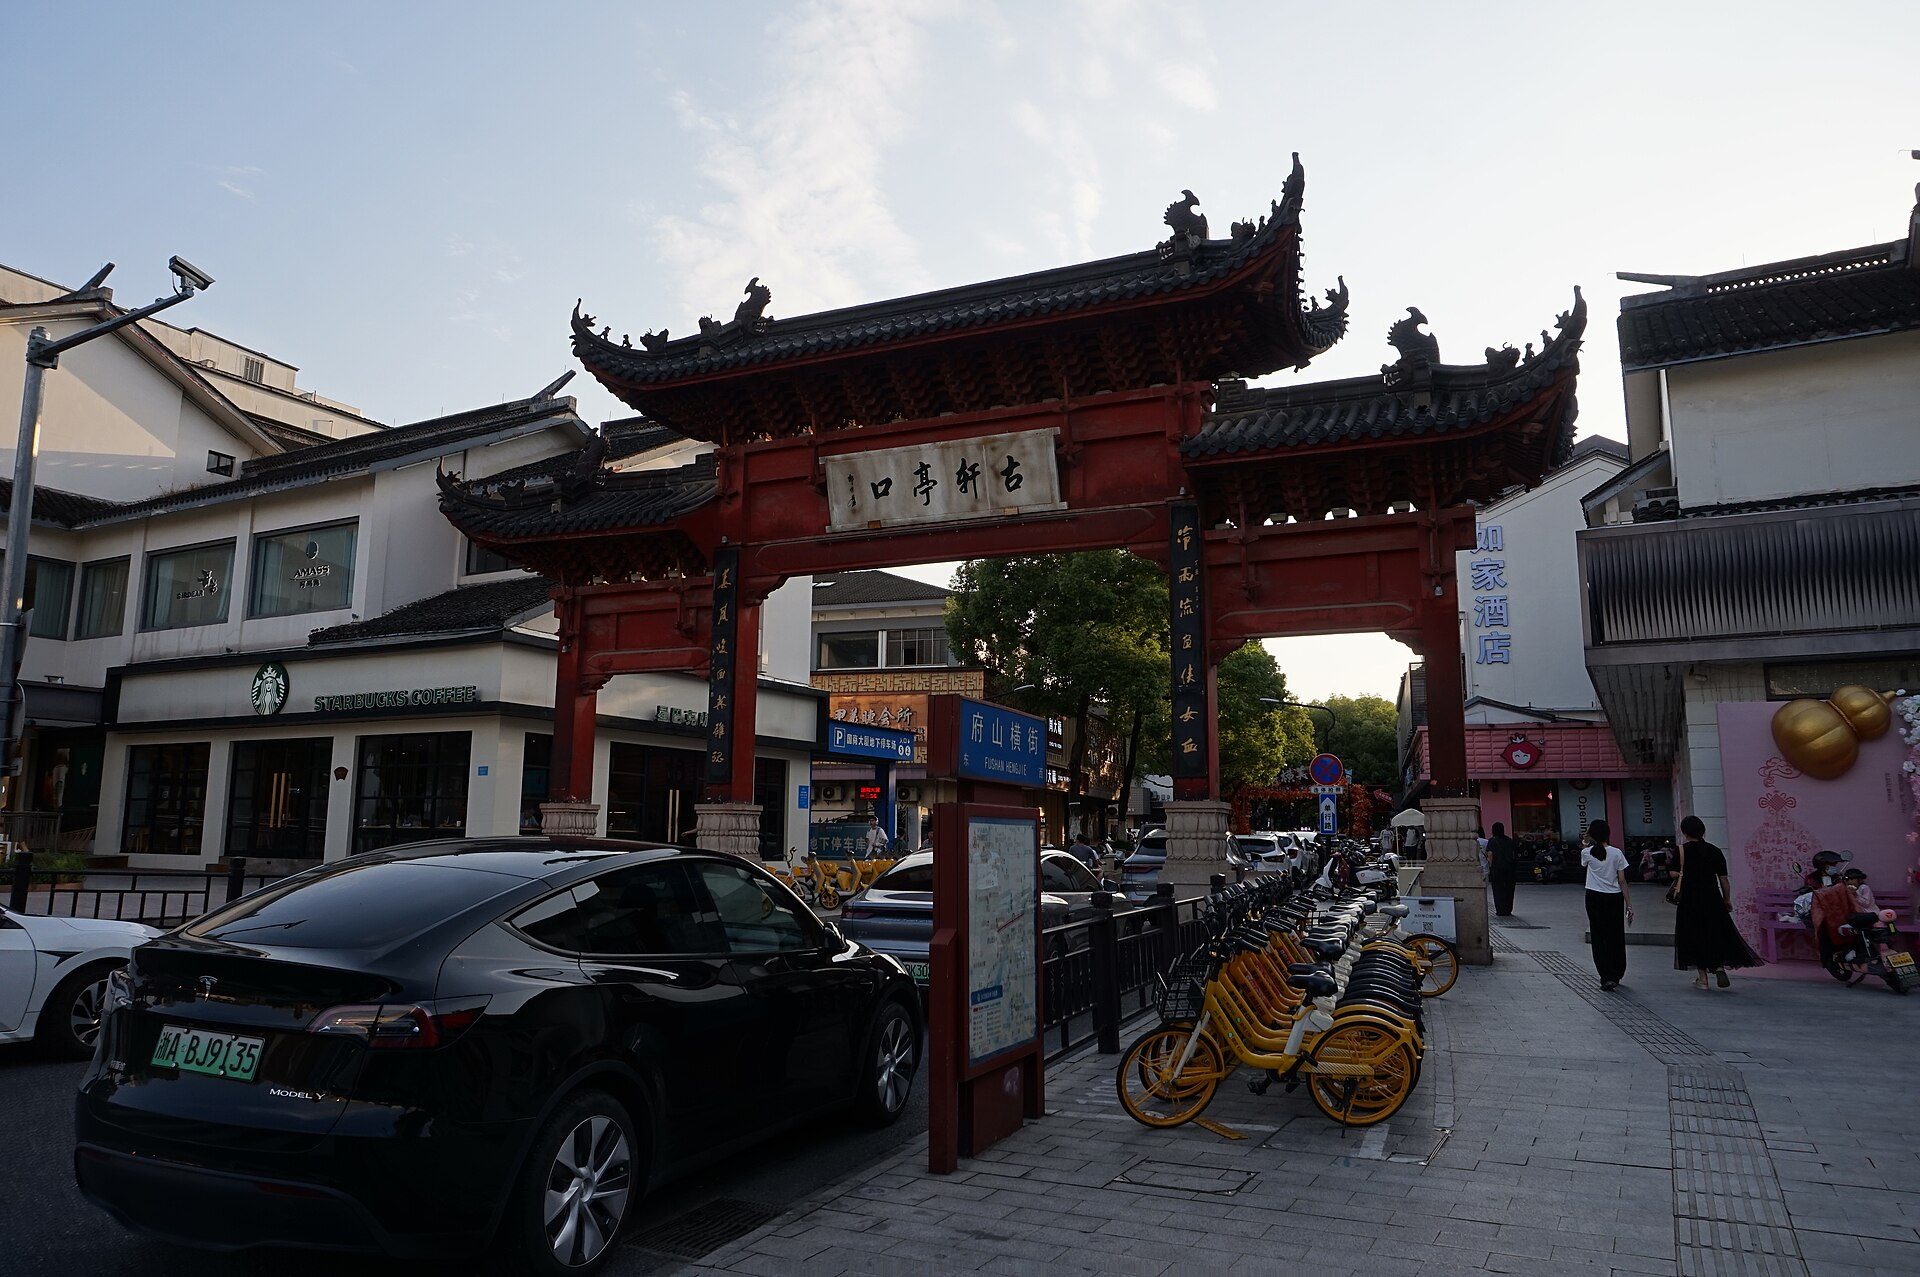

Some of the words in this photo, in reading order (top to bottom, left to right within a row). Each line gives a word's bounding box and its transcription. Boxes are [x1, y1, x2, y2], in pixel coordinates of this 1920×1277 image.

[293, 564, 330, 578] AMASS
[1470, 522, 1511, 665] 如家酒店
[313, 690, 409, 712] STARBUCKS
[411, 685, 478, 706] COFFEE
[970, 711, 1039, 756] 府山横街
[963, 753, 970, 768] 东
[984, 756, 1004, 772] FUSHAN
[1005, 761, 1027, 776] HENGJIE
[1046, 769, 1058, 784] 大福
[1324, 804, 1332, 830] 单行路
[269, 1088, 313, 1100] MODEL
[315, 1091, 327, 1101] Y
